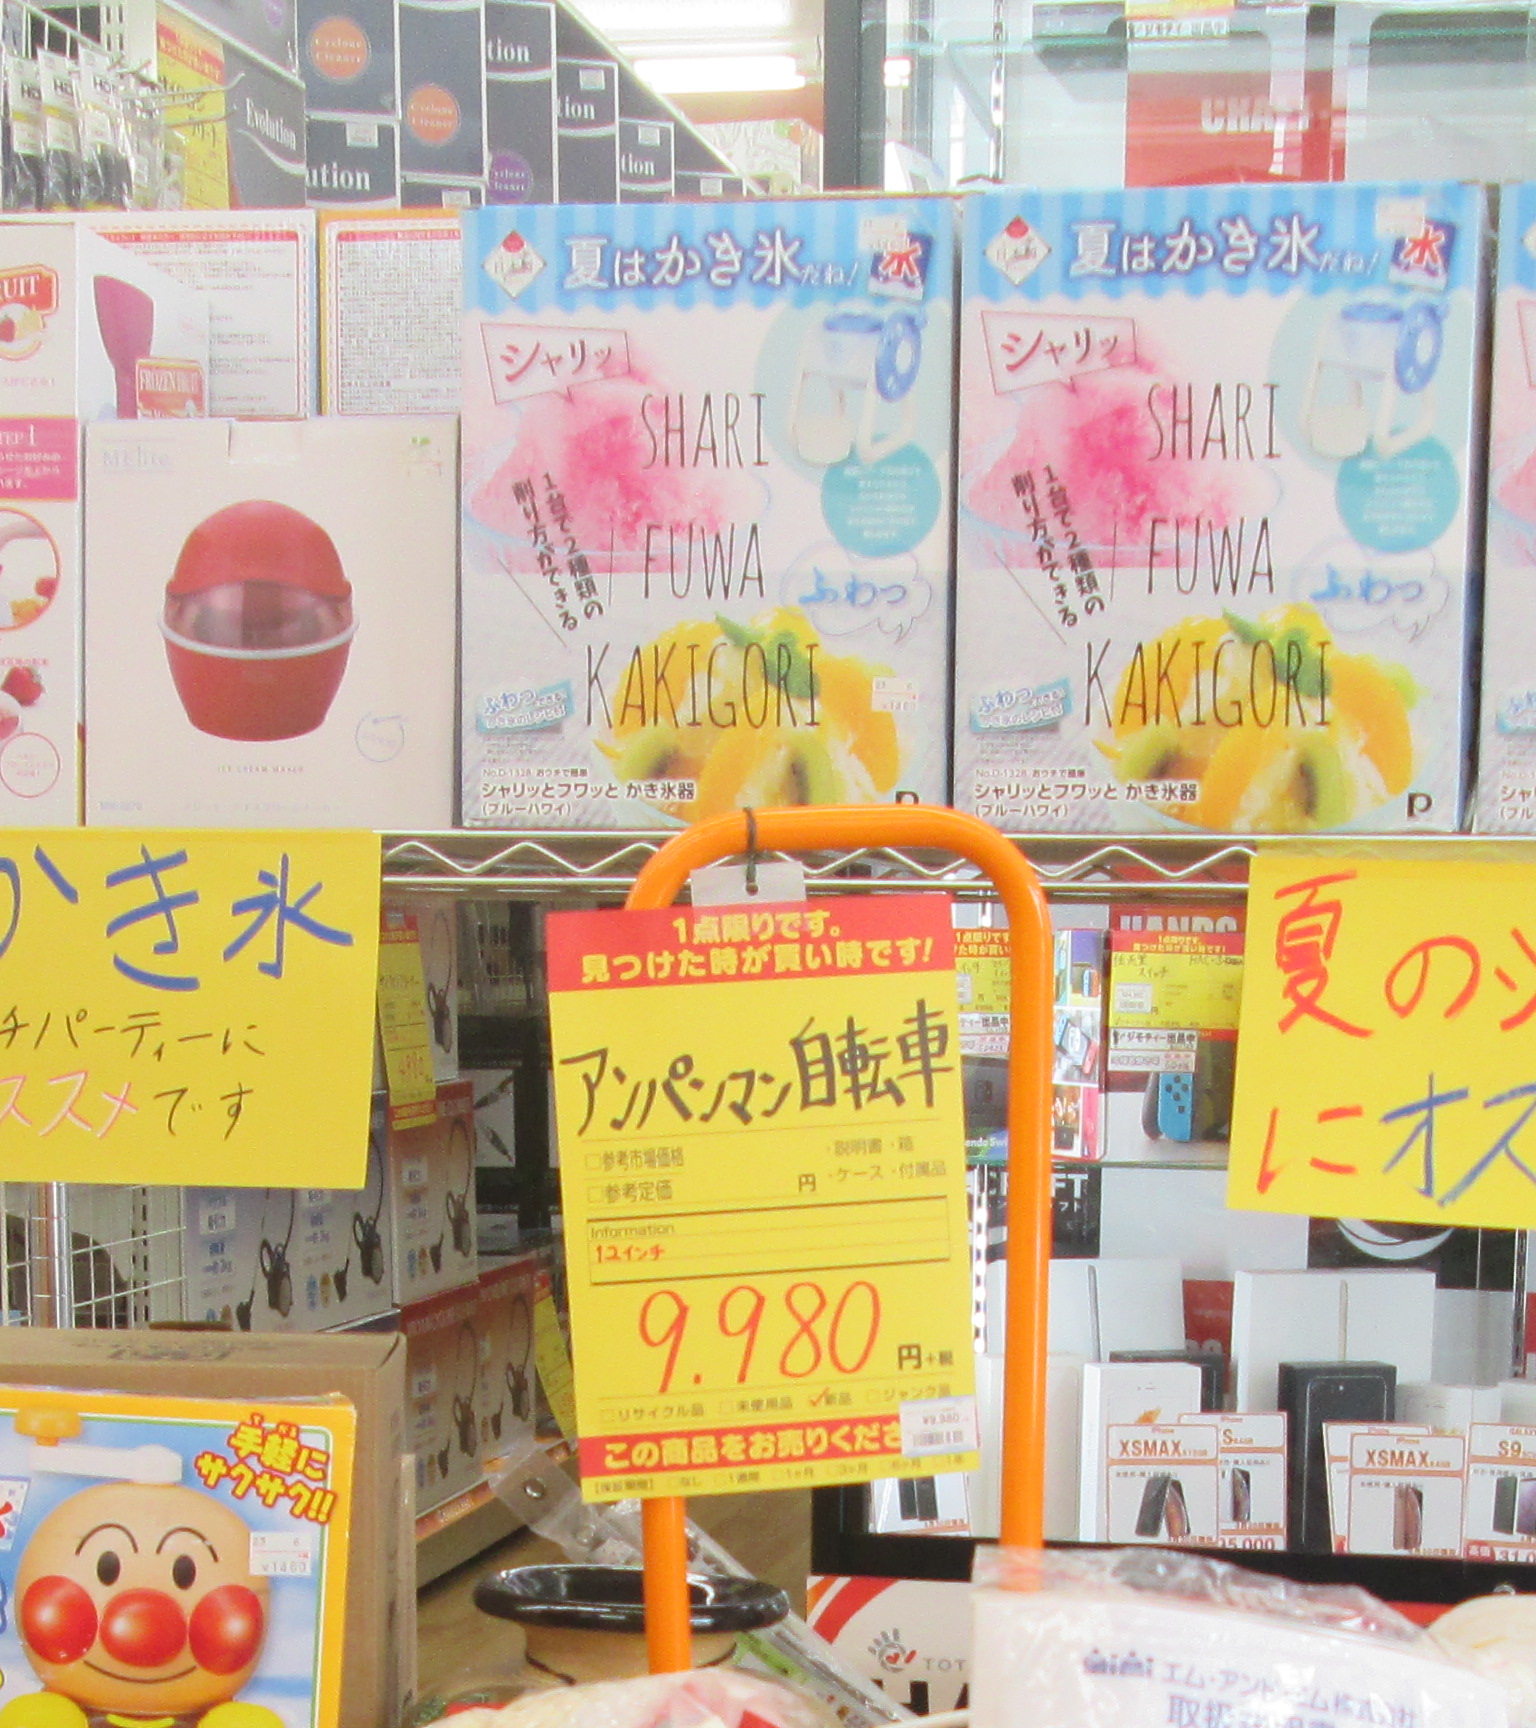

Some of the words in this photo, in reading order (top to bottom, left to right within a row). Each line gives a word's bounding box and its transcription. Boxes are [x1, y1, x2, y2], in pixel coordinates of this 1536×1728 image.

[498, 338, 614, 382] シャリッ
[1000, 328, 1118, 372] シャリッ
[28, 423, 37, 447] 1
[641, 392, 770, 470] SHARI
[1147, 383, 1281, 462] SHARI
[643, 523, 766, 600] FUWA
[1147, 517, 1276, 596] FUWA
[585, 642, 822, 731] KAKIGORI
[1085, 640, 1333, 729] KAKIGORI
[482, 782, 619, 799] シャリッとフワッと
[625, 781, 695, 800] かき氷器
[482, 802, 571, 816] (ブルーハワイ)
[974, 783, 1118, 801] シャリッとフワッと
[1125, 782, 1198, 801] かき氷器
[975, 804, 1069, 818] (ブルーハワイ)
[672, 908, 844, 945] 1点限りです。
[580, 934, 935, 985] 見つけた時が買い時です!
[558, 997, 955, 1138] アンパンマン自転車
[798, 1173, 817, 1193] 円
[590, 1222, 676, 1239] Information
[594, 1243, 666, 1264] 12インチ
[1118, 1439, 1182, 1458] XSMAX
[1364, 1448, 1431, 1469] XSMAX
[1498, 1441, 1522, 1458] S9
[196, 1452, 336, 1523] サクサク!!
